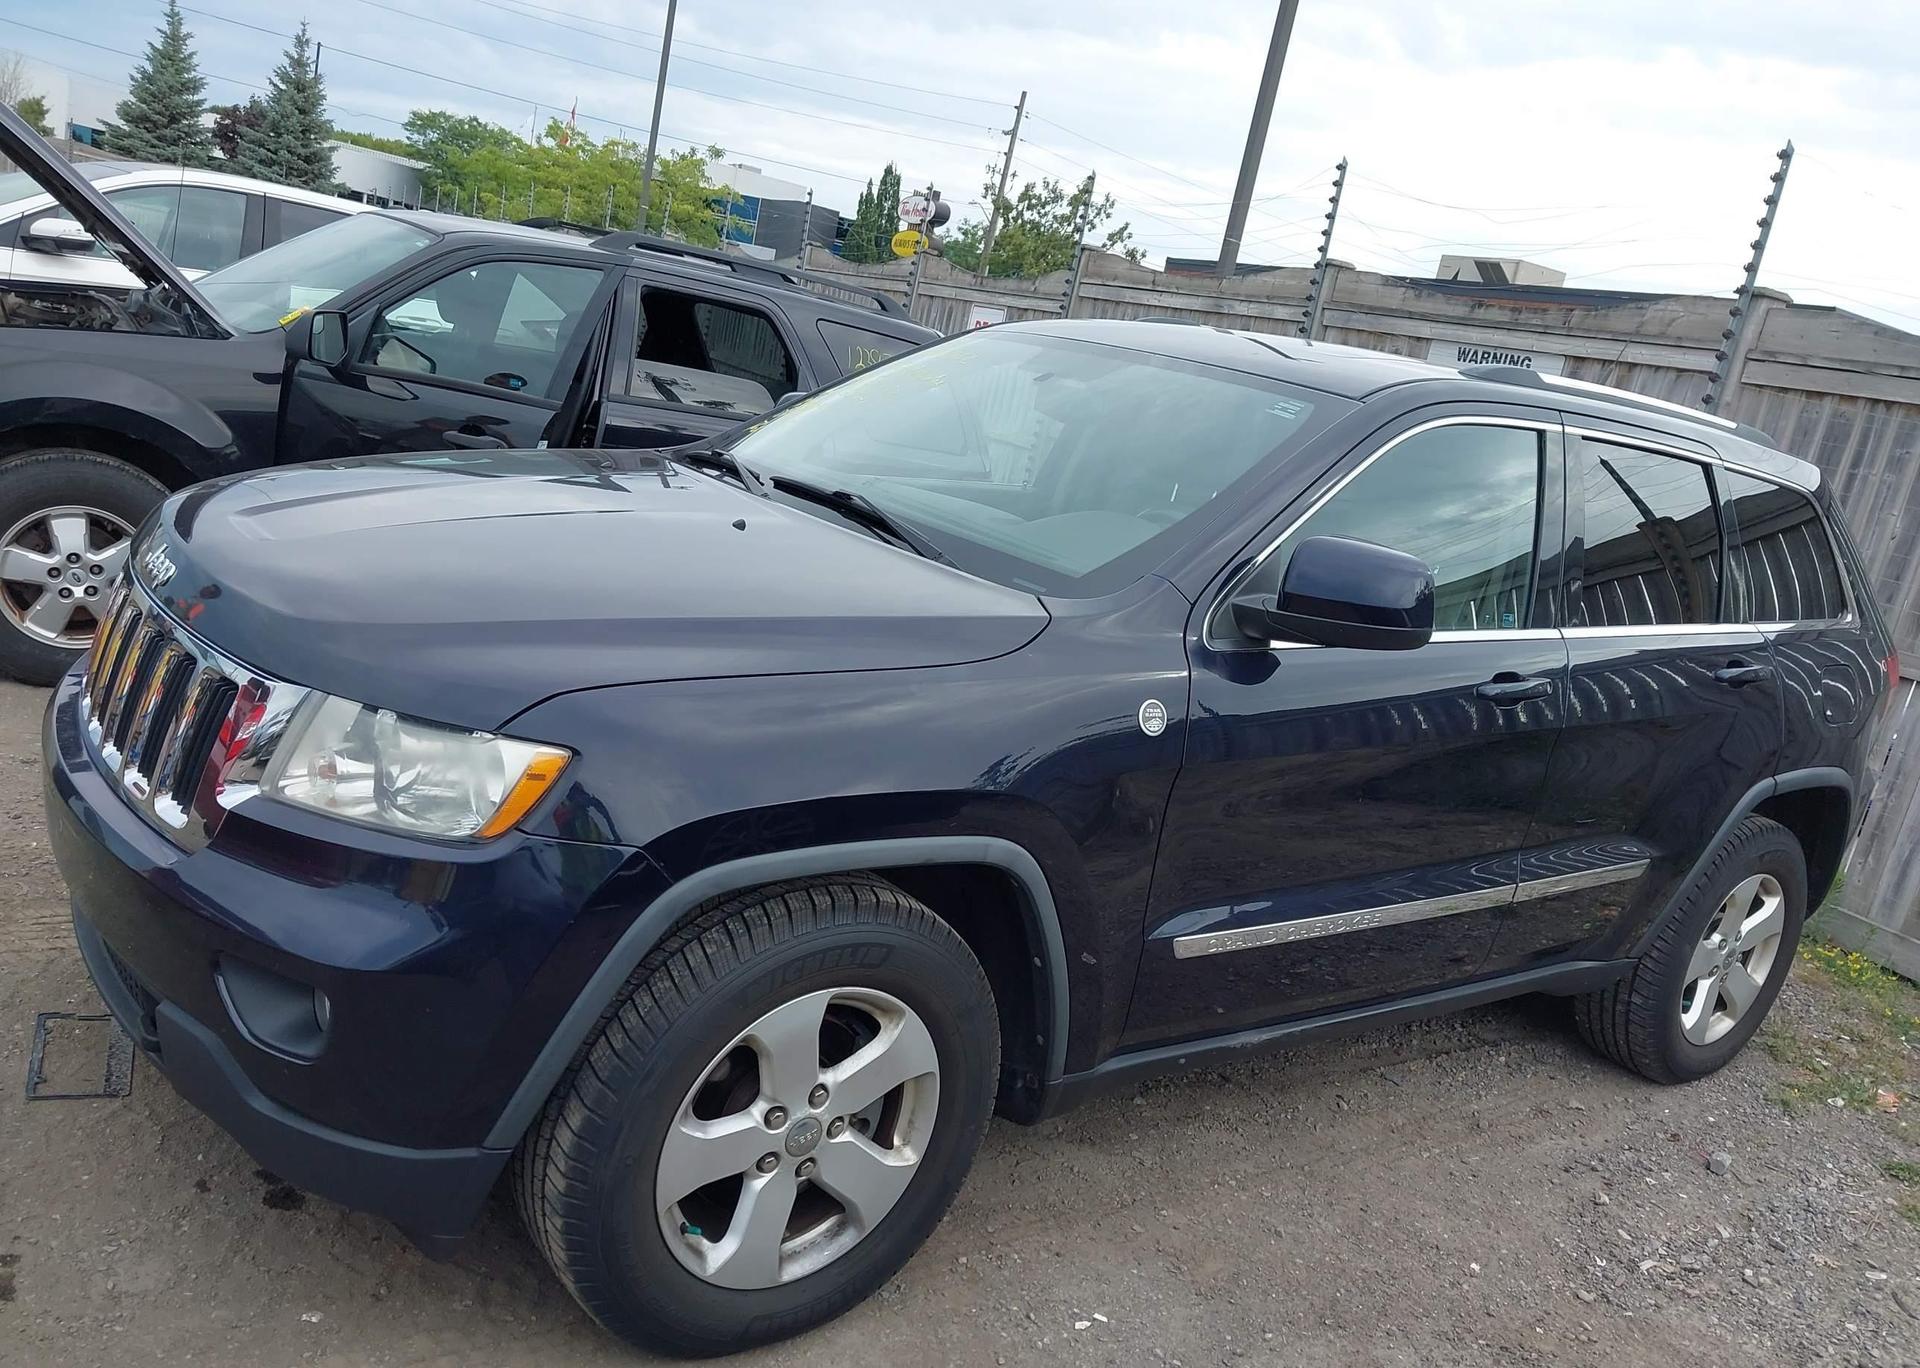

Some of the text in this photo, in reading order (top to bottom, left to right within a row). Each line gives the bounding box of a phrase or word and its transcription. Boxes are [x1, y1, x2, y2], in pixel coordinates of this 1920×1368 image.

[1457, 346, 1532, 369] WARNING
[145, 543, 177, 589] Jeep
[1207, 913, 1383, 953] GRAND CHEROKEE
